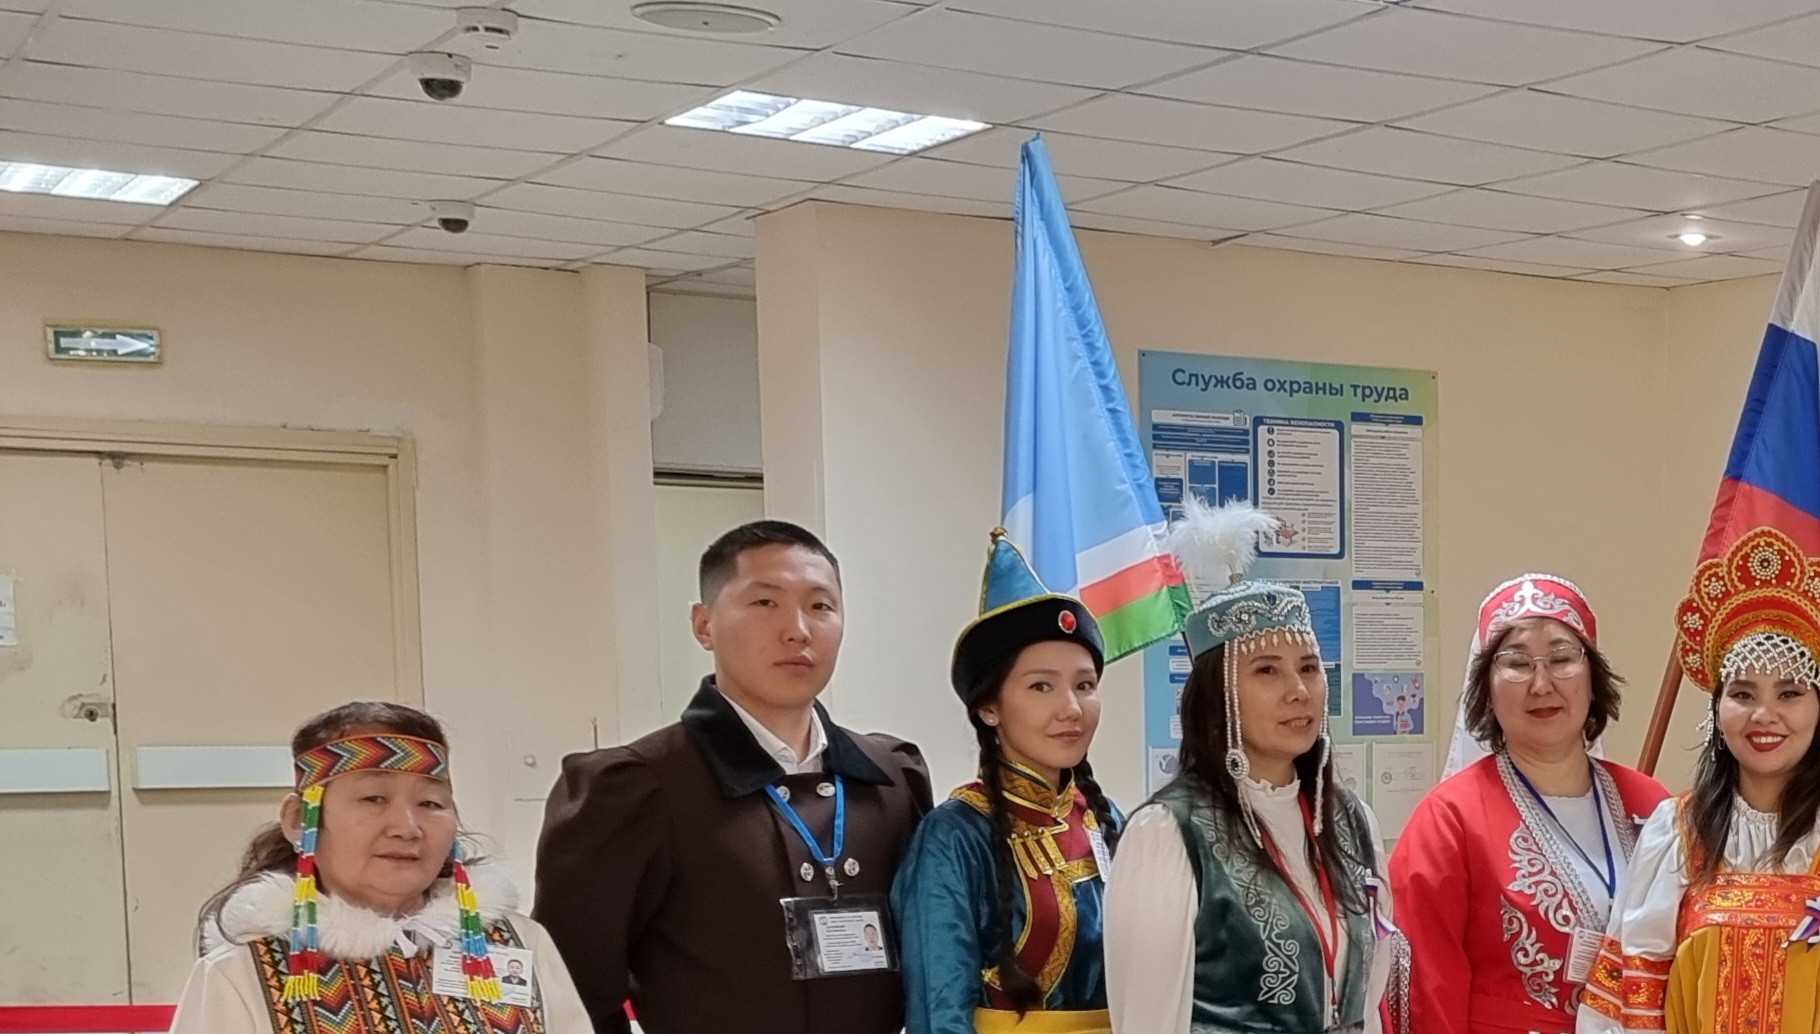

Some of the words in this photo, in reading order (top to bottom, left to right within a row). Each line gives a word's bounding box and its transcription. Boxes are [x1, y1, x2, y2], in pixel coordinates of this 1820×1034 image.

[1171, 368, 1257, 392] Служба
[1263, 377, 1344, 397] охраны
[1350, 383, 1410, 403] труда
